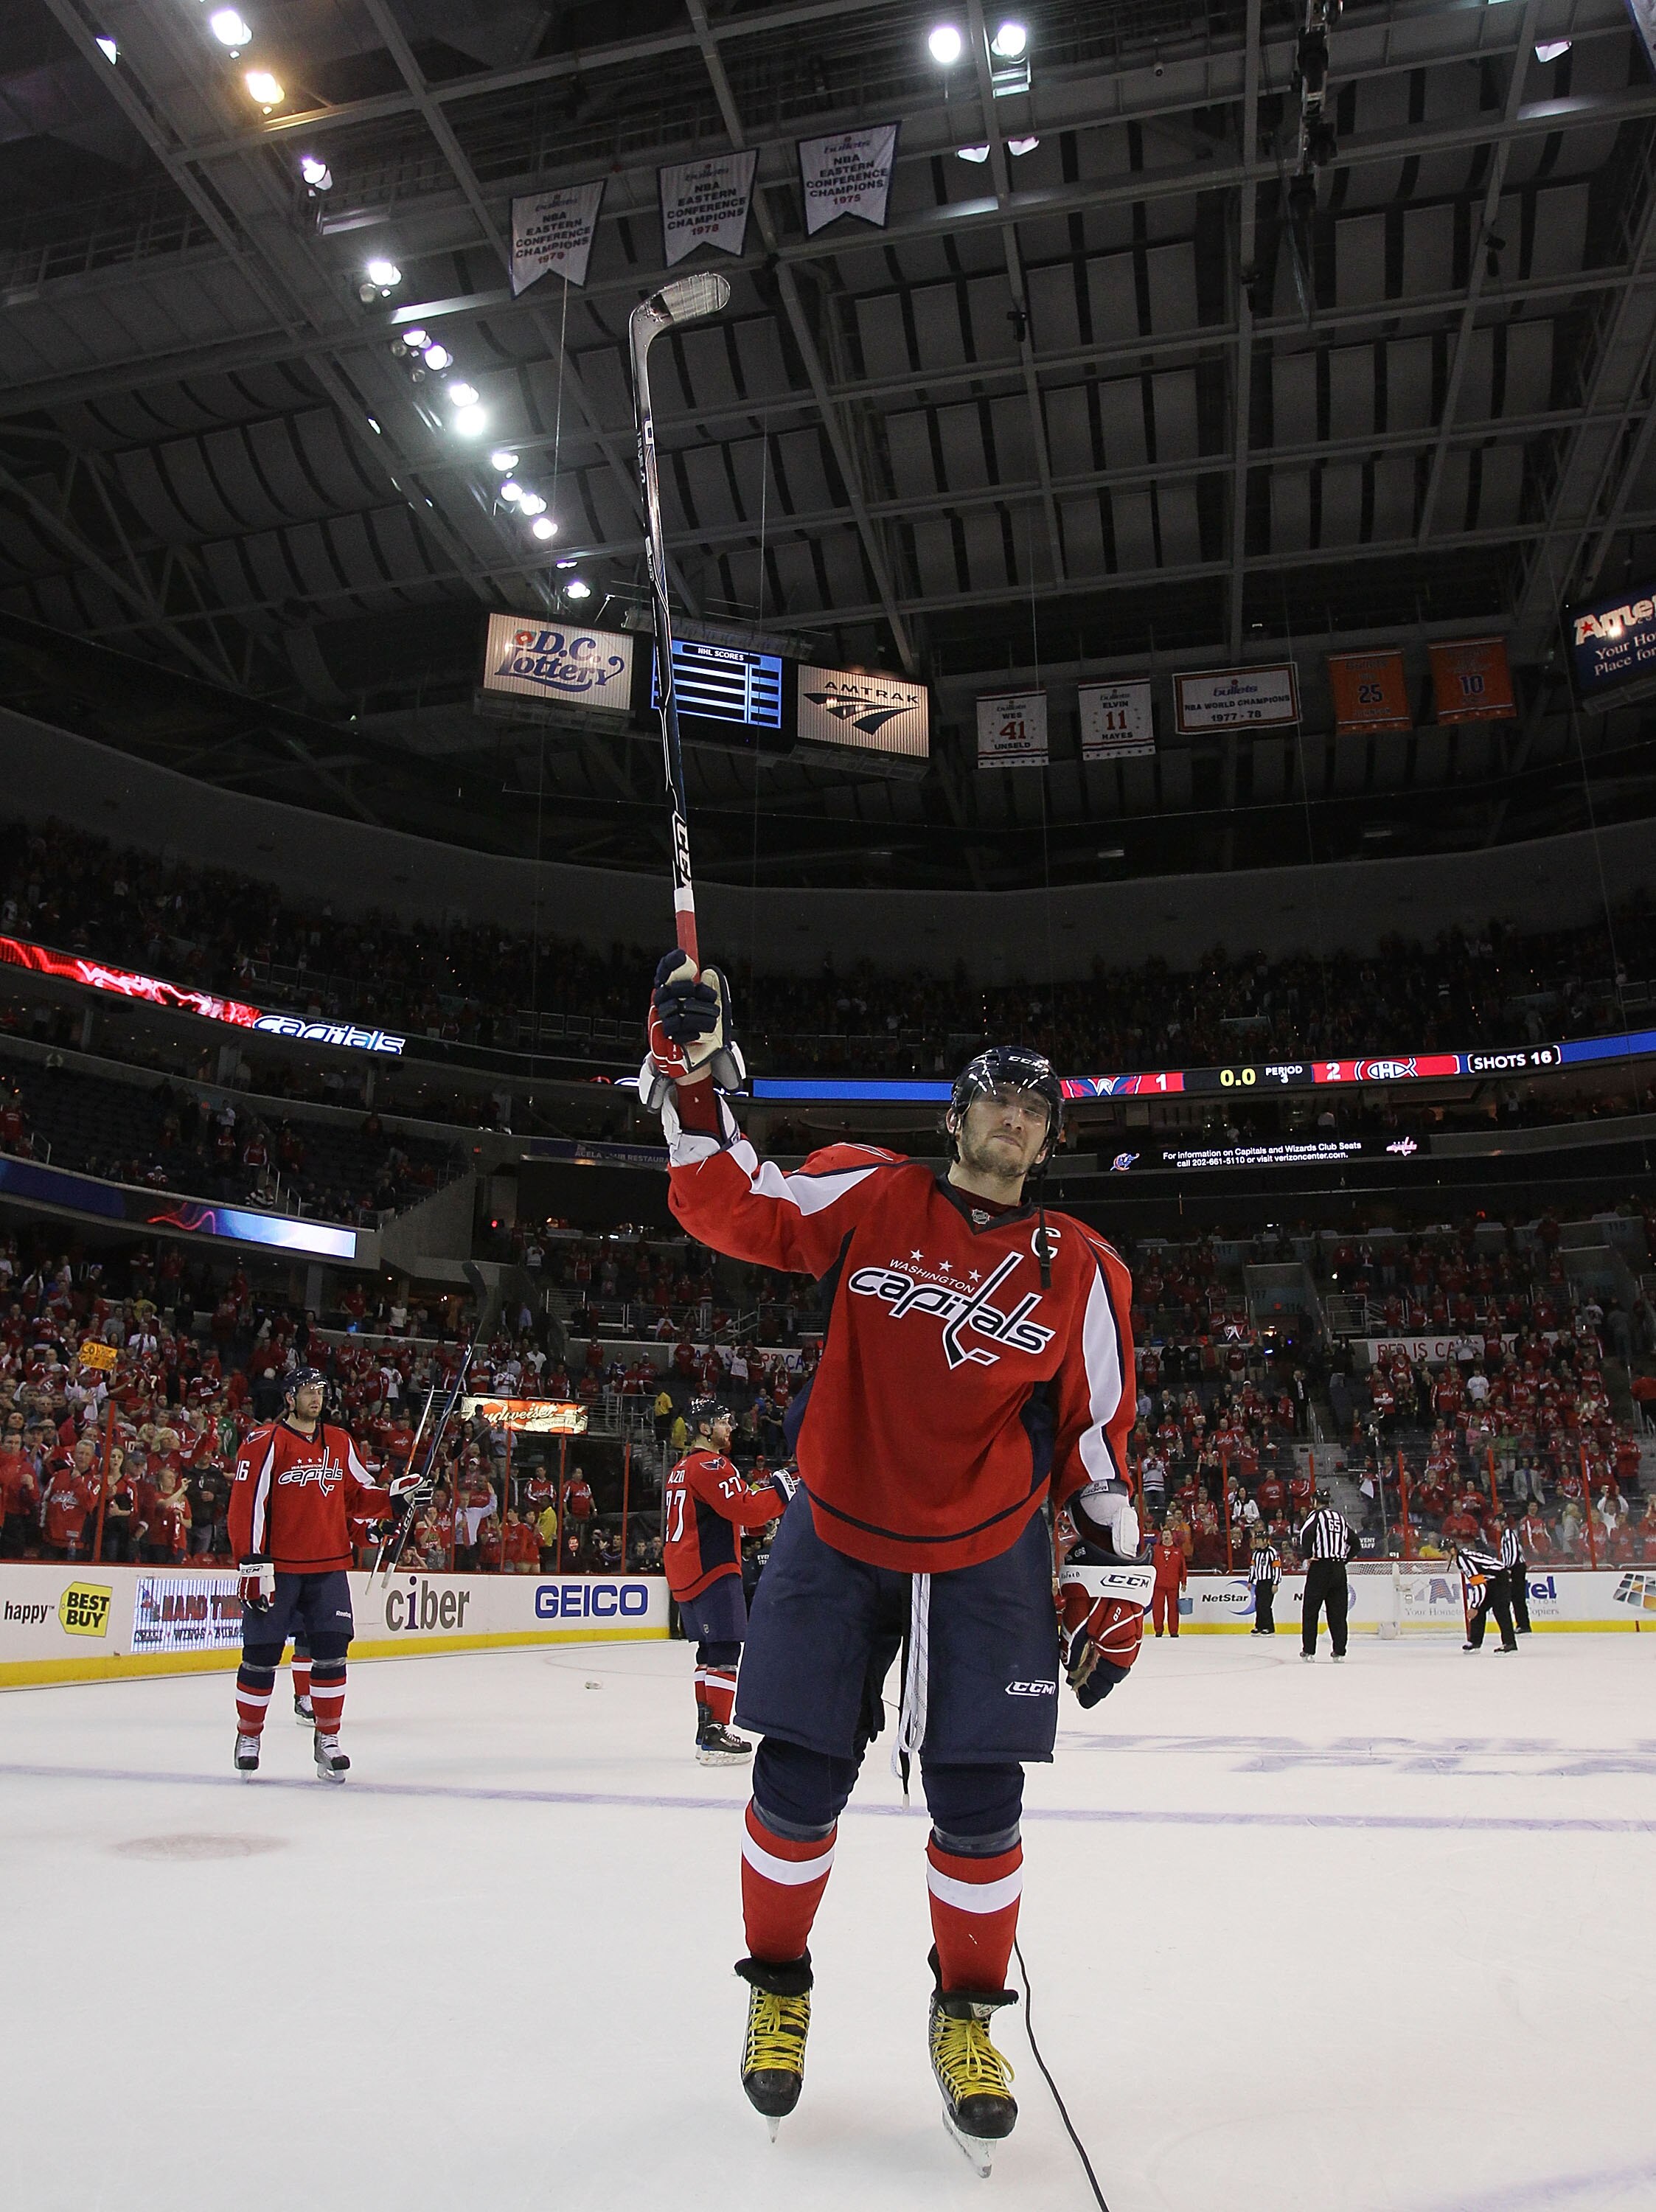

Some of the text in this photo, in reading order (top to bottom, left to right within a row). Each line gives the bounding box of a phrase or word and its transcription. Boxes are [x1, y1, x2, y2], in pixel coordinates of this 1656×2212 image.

[820, 160, 874, 177] EASTERN
[834, 154, 860, 165] NBA
[695, 181, 720, 193] NBA
[807, 168, 888, 188] CONFERENCE
[810, 179, 883, 197] CHAMPIONS
[678, 189, 737, 206] EASTERN
[833, 194, 860, 205] 1975
[543, 212, 566, 222] NBA
[667, 197, 746, 219] CONFERENCE
[526, 218, 582, 236] EASTERN
[668, 207, 744, 230] CHAMPIONS
[516, 226, 591, 248] CONFERENCE
[516, 237, 589, 258] CHAMPIONS
[527, 630, 602, 661] D.C.
[697, 647, 744, 661] NHL SCORES
[1596, 632, 1656, 660] Your Ho
[494, 647, 625, 692] Lottery
[1594, 656, 1632, 676] Place
[824, 681, 919, 703] AMTRAK
[1459, 673, 1485, 695] 10
[1205, 700, 1236, 709] WORLD
[1237, 694, 1290, 706] CHAMPIONS
[1358, 684, 1383, 703] 25
[1103, 700, 1129, 709] ELVIN
[1106, 709, 1127, 731] 11
[1211, 712, 1237, 722] 1977
[1248, 710, 1262, 718] 78
[999, 720, 1026, 740] 41
[1102, 731, 1133, 740] HAYES
[994, 742, 1031, 750] UNSELD
[1474, 1050, 1552, 1070] SHOTS 16
[1220, 1068, 1256, 1087] 0.0
[1265, 1065, 1303, 1077] PERIOD
[1280, 1073, 1289, 1084] 3
[1326, 1062, 1341, 1079] 2
[1155, 1074, 1167, 1091] 1
[574, 1150, 602, 1159] ACELA
[1178, 1150, 1222, 1158] information
[1234, 1146, 1267, 1156] Capitals
[1268, 1144, 1284, 1153] and
[1285, 1143, 1317, 1152] Wizards
[1318, 1143, 1337, 1151] Club
[1339, 1141, 1362, 1150] Seats
[1177, 1159, 1191, 1167] call
[1192, 1156, 1245, 1166] 202-661-5110
[1256, 1155, 1273, 1163] visit
[1030, 1227, 1062, 1259] C
[889, 1259, 976, 1294] WASHINGTON
[849, 1251, 1056, 1370] capitals
[1413, 1342, 1427, 1359] IS
[278, 1446, 344, 1498] capitals
[718, 1476, 743, 1500] 27
[1328, 1519, 1341, 1532] 65
[1109, 1573, 1149, 1588] CCM
[67, 1591, 110, 1612] BEST
[385, 1576, 471, 1632] ciber
[535, 1584, 650, 1619] GEICO
[1201, 1593, 1249, 1602] NetStar
[66, 1609, 104, 1628] BUY
[1405, 1607, 1425, 1616] Your
[1012, 1681, 1054, 1695] CCM
